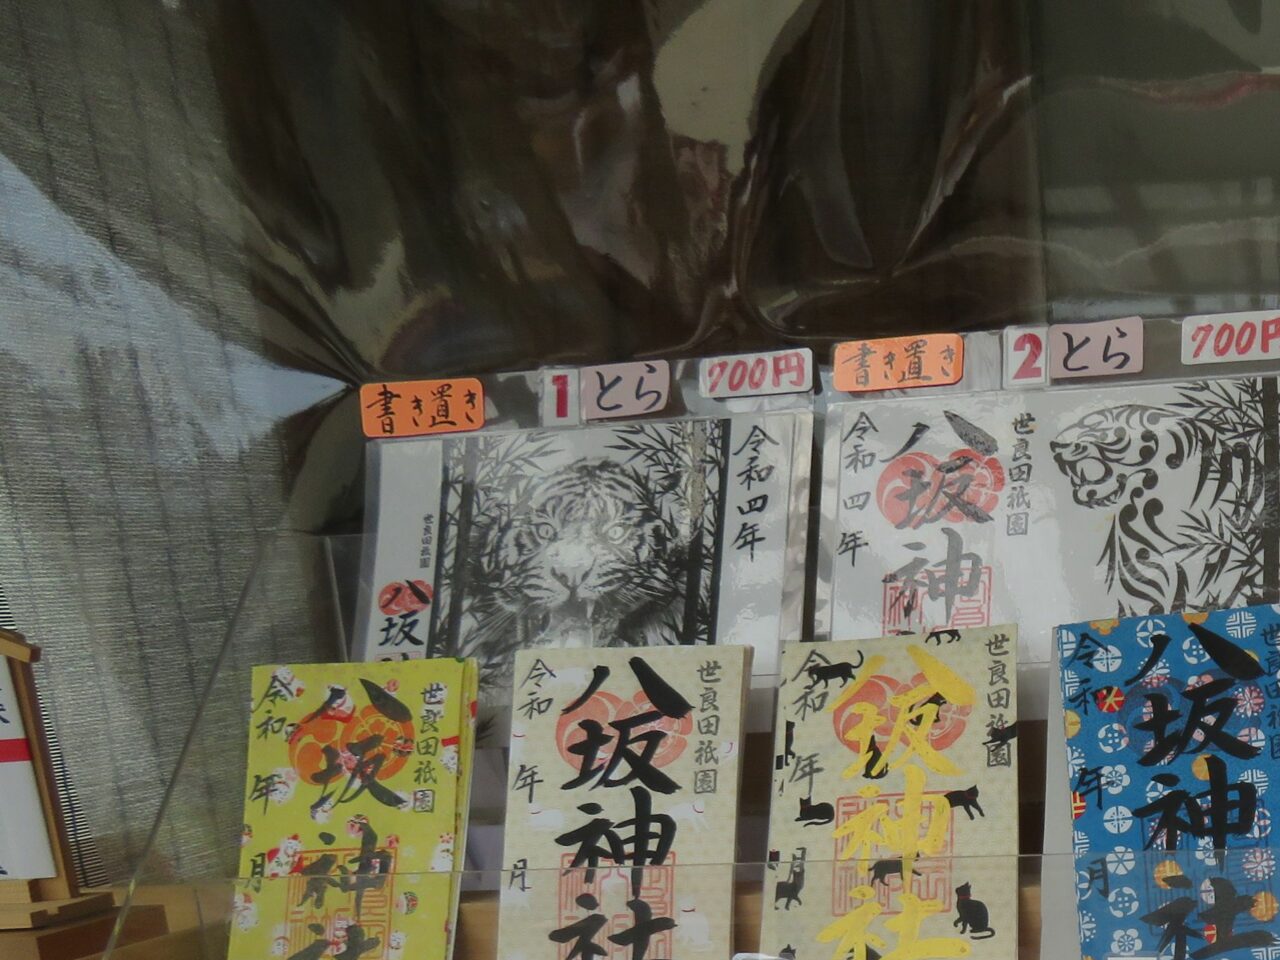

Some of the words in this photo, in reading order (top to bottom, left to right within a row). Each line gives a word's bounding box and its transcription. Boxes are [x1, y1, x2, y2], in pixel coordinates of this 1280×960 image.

[706, 352, 806, 393] 700円
[841, 340, 959, 387] 書き置き
[1012, 333, 1044, 380] 2
[1061, 326, 1132, 372] とら
[366, 383, 479, 436] 書き置き
[551, 374, 569, 418] 1
[595, 363, 664, 413] とら
[731, 424, 781, 563] 令和四年
[1005, 412, 1036, 538] 世良田祇園
[881, 409, 999, 636] 八坂神
[378, 578, 434, 661] 八坂
[517, 657, 557, 720] 令和
[983, 632, 1014, 769] 世良田祇園
[412, 681, 445, 814] 世良田祇園
[693, 659, 721, 795] 世良田祇園
